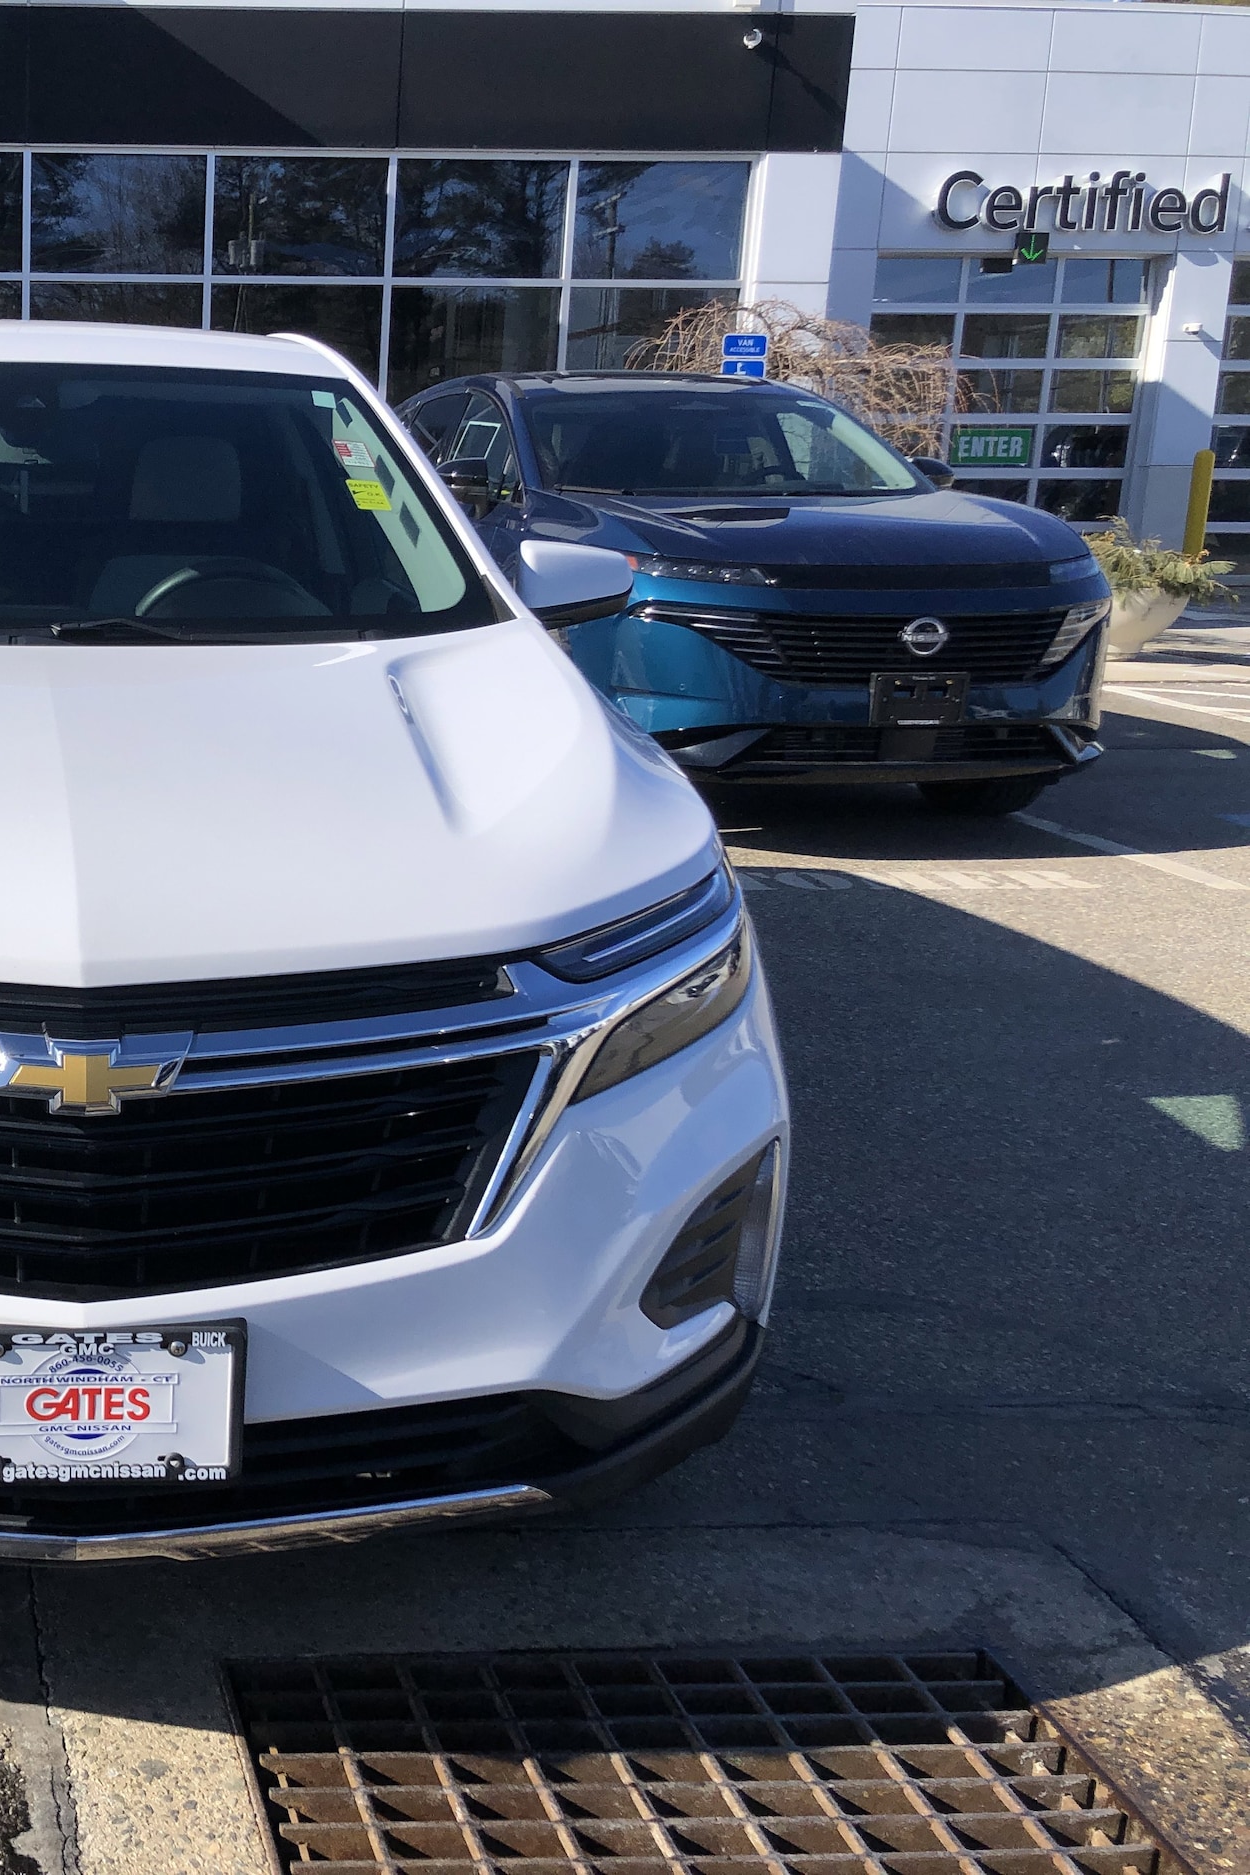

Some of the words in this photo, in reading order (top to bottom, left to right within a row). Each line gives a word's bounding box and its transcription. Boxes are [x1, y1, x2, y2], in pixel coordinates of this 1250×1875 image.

[937, 169, 1233, 234] Certified
[958, 436, 1023, 457] ENTER
[11, 1332, 164, 1345] GATES
[191, 1331, 227, 1347] BUICK
[59, 1343, 116, 1356] GMC
[49, 1354, 124, 1374] 860-456-0055
[0, 1374, 54, 1384] NORTH
[56, 1374, 133, 1384] WINDHAM
[152, 1375, 173, 1383] CT
[25, 1387, 151, 1421] GATES
[44, 1435, 125, 1456] gatesgmcnissan.com
[3, 1461, 166, 1482] gatesgmcnissan
[178, 1466, 227, 1480] .com
